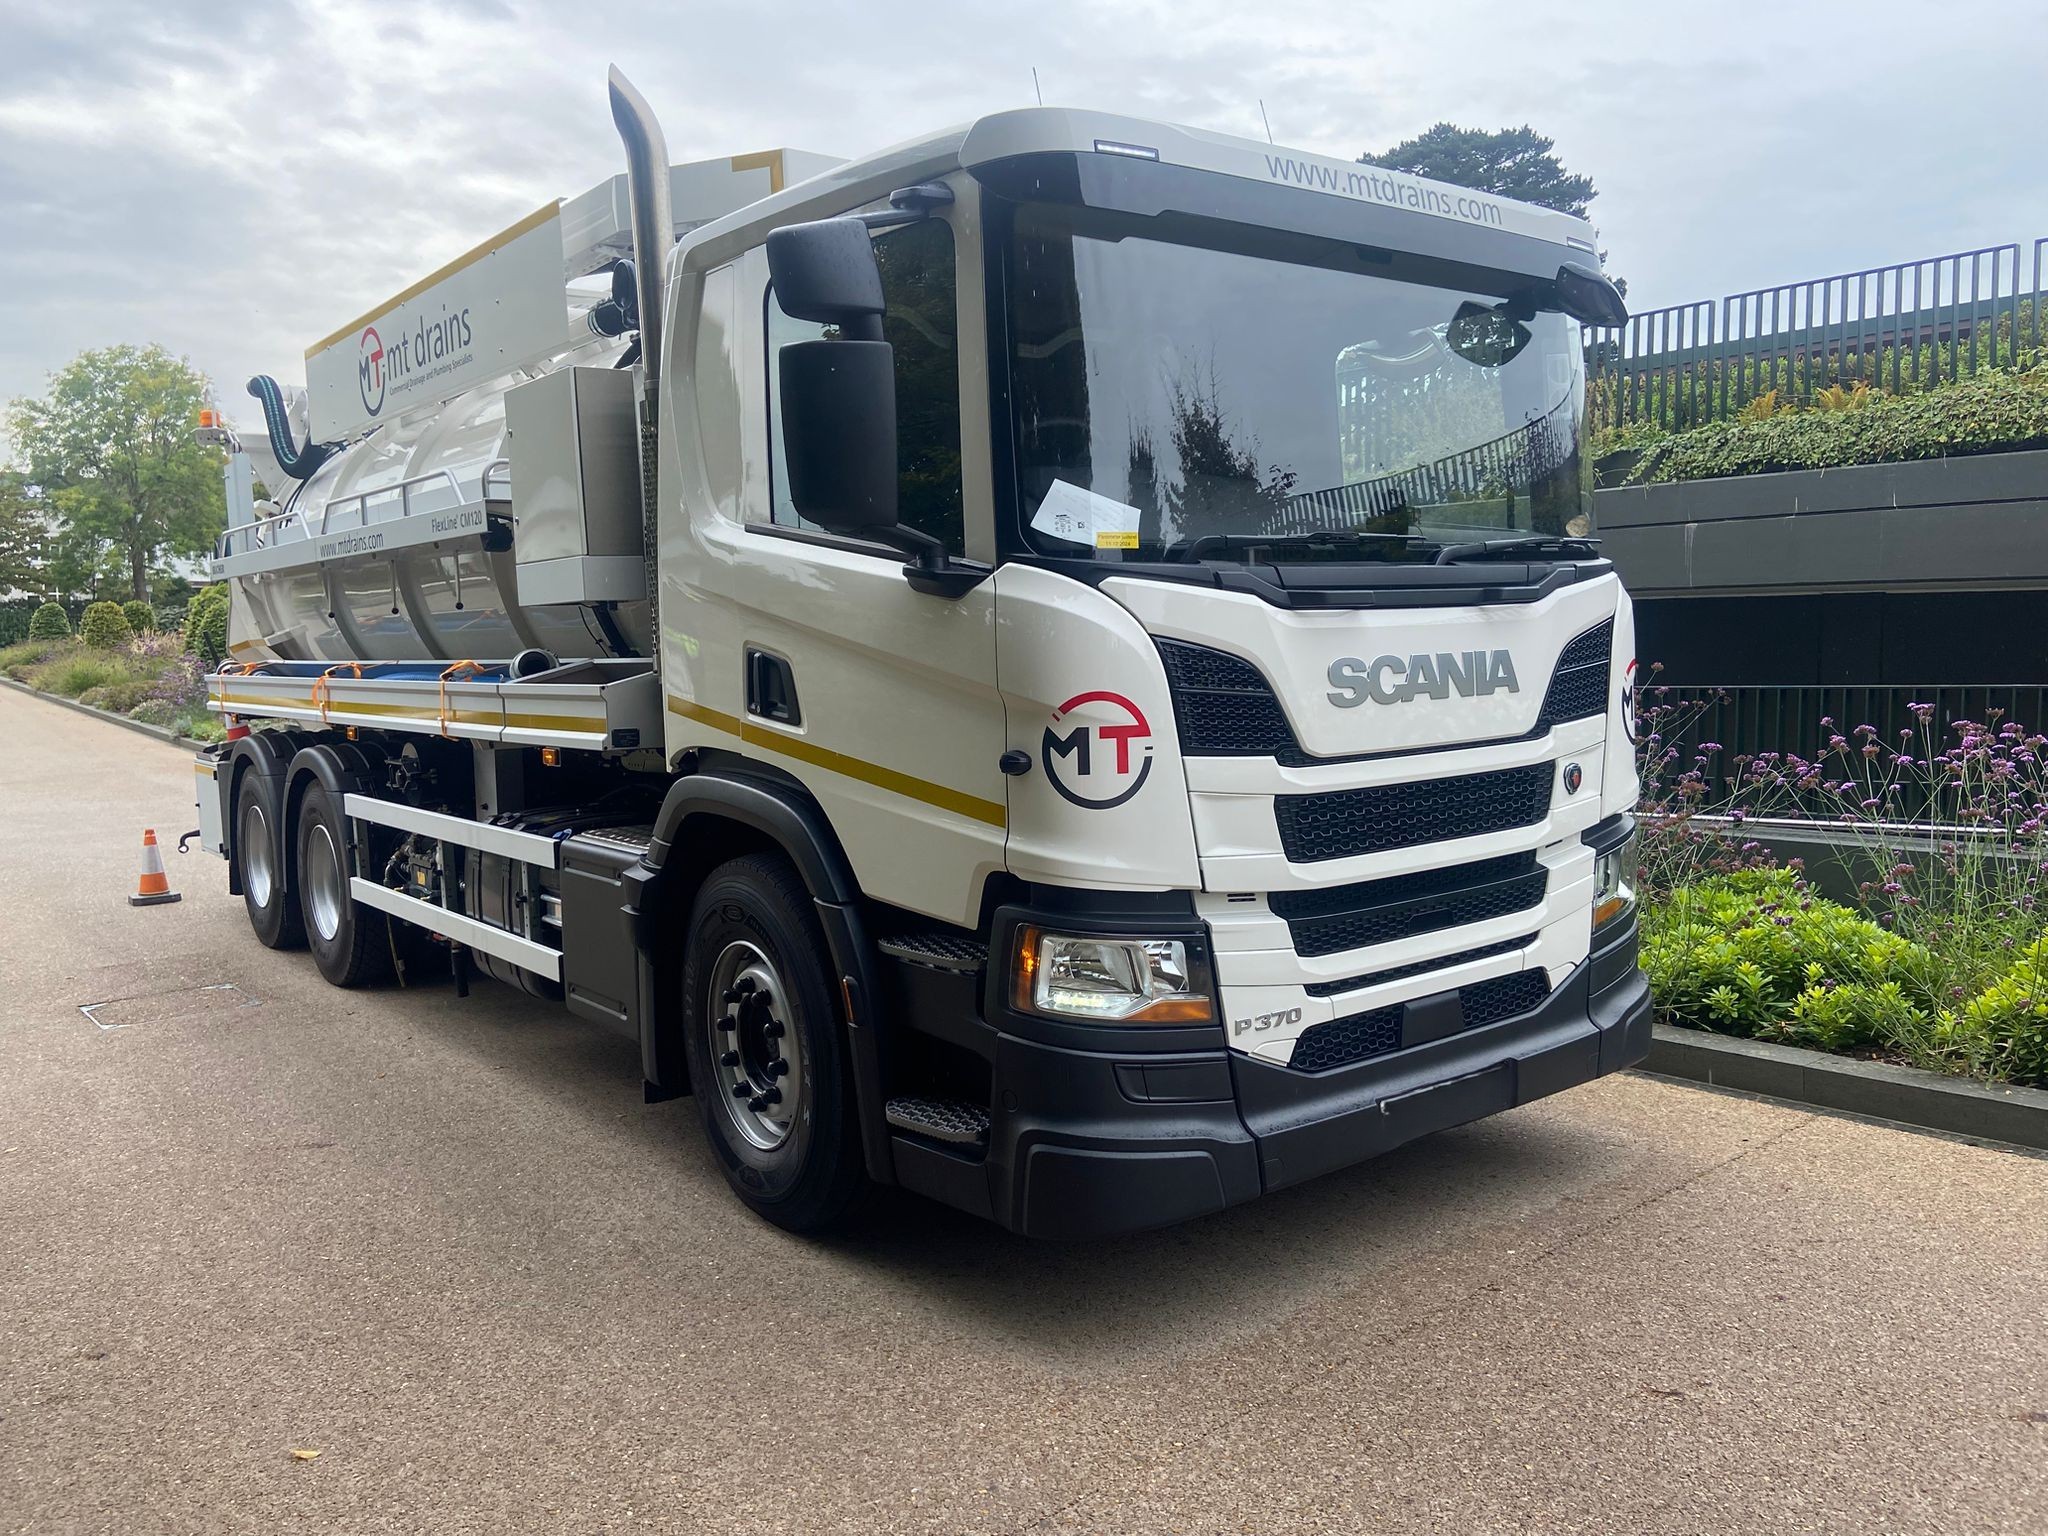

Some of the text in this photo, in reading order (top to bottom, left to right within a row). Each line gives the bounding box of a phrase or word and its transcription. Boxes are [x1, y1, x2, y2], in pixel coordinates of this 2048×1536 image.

[1264, 154, 1503, 225] www.mtdrains.com
[387, 304, 472, 381] mt drains
[460, 510, 483, 527] CM120
[320, 531, 384, 557] www.mtdrains.com
[1327, 650, 1519, 708] SCANIA
[1234, 1007, 1302, 1036] P 370
